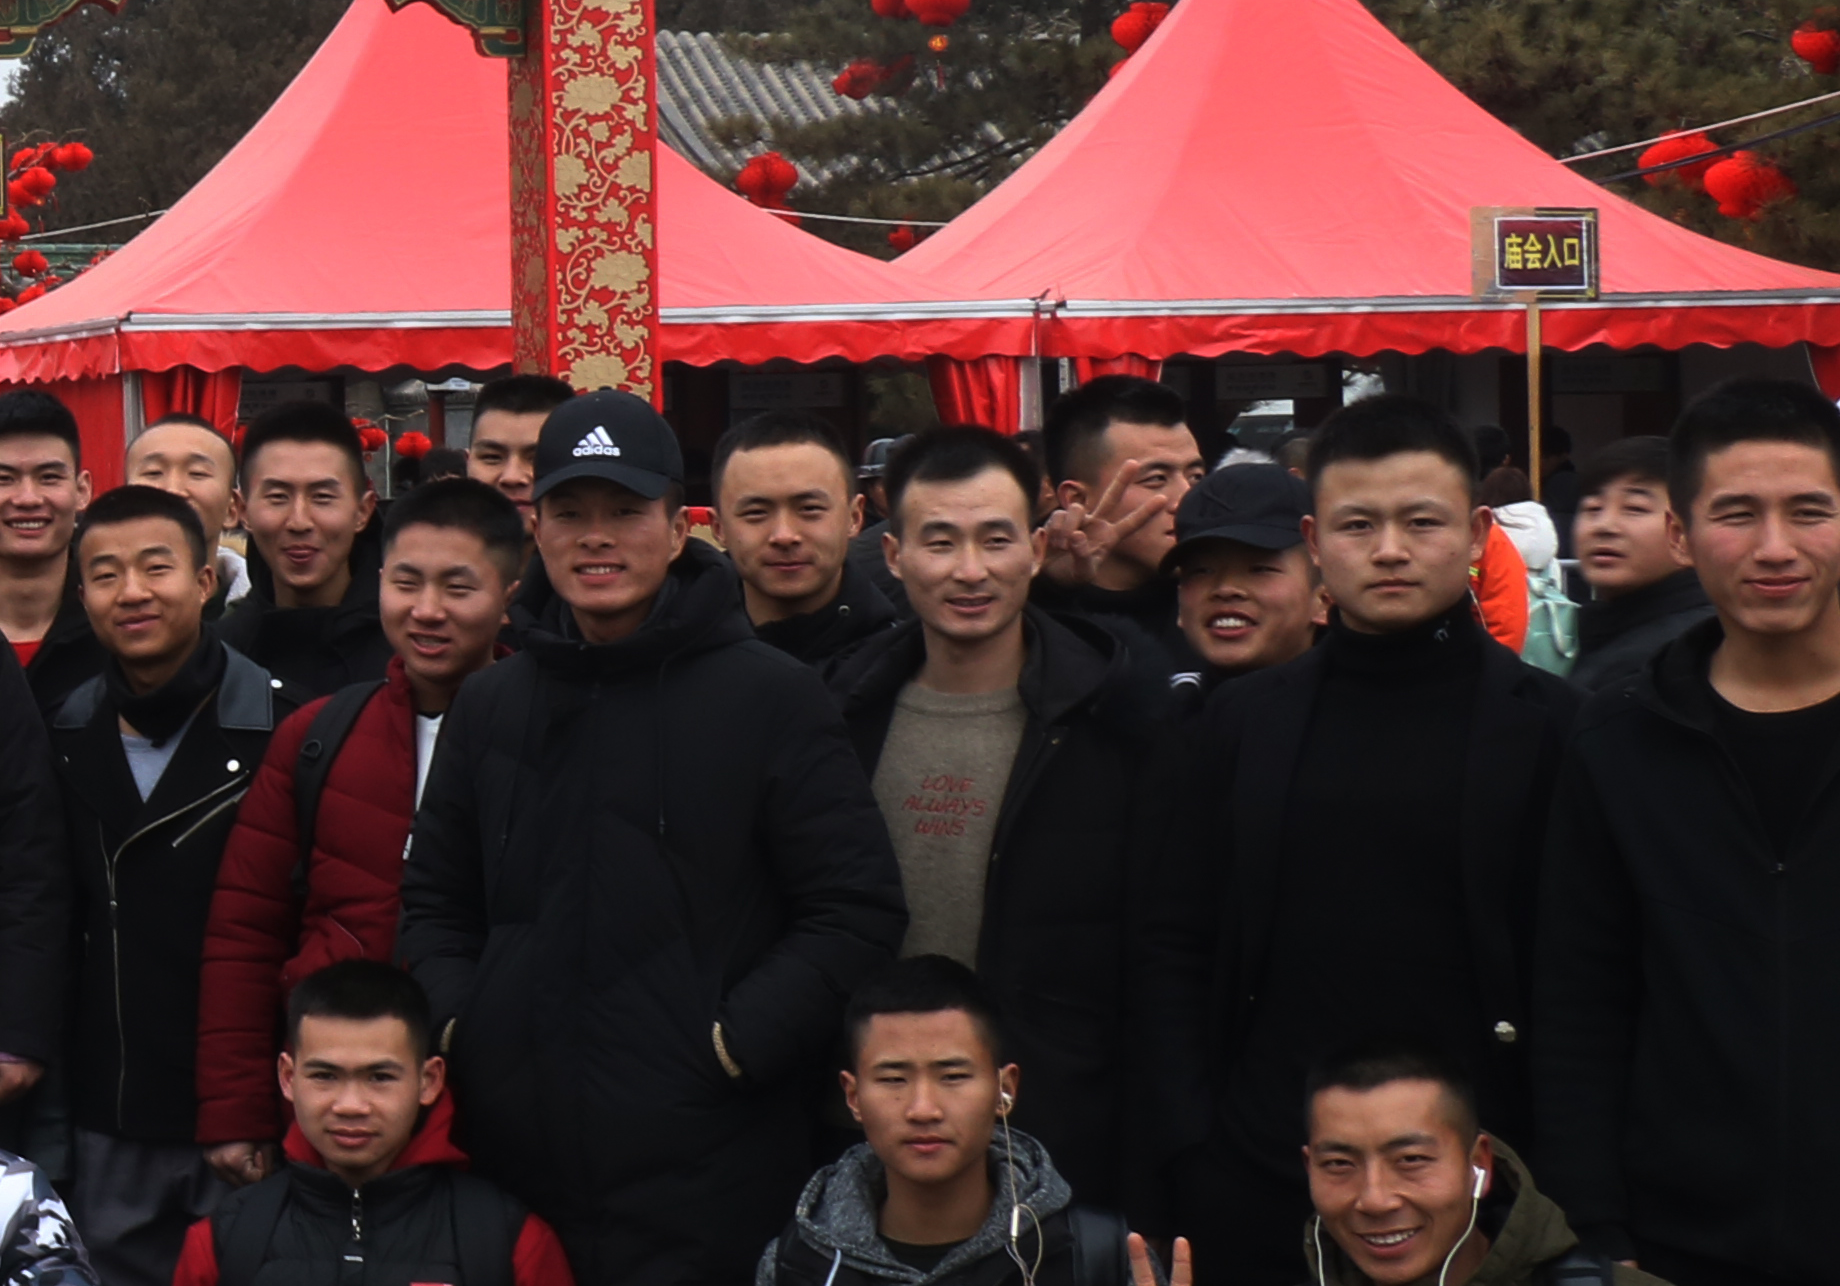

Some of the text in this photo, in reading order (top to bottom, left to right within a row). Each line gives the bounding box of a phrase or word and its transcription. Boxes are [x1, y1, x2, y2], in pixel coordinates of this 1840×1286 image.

[1504, 233, 1580, 270] 庙会入口
[572, 445, 621, 457] adidas
[922, 775, 975, 793] LOVE
[902, 794, 987, 816] ALWAYS
[914, 818, 968, 836] WINS
